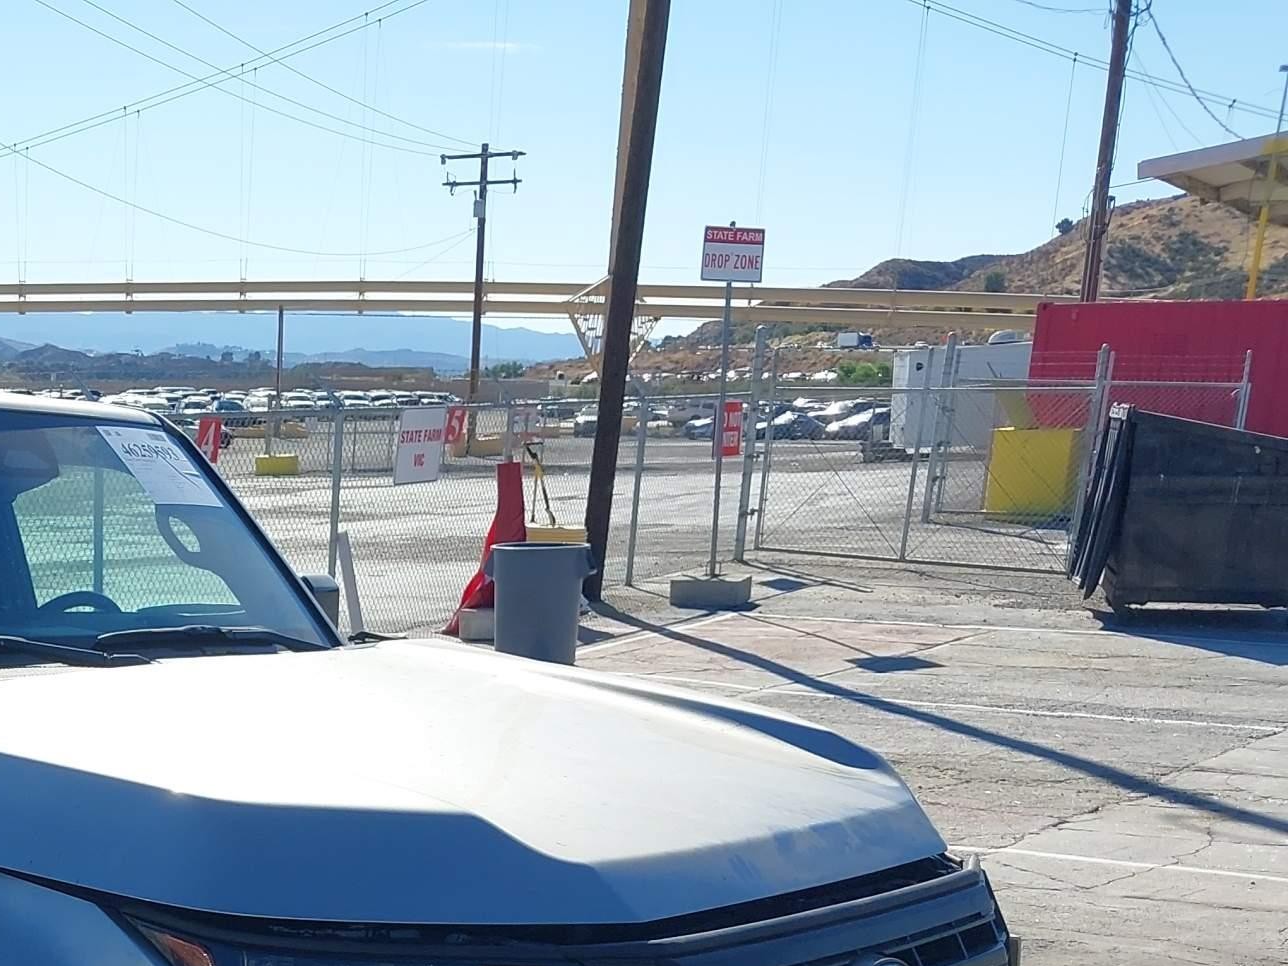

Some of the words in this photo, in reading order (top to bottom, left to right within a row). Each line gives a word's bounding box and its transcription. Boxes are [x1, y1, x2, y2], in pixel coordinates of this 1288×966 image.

[706, 230, 734, 241] STATE
[736, 231, 762, 242] FARM
[704, 253, 730, 269] DROP
[733, 254, 760, 270] ZONE
[447, 409, 463, 441] 5
[200, 420, 216, 462] 4
[400, 430, 423, 444] STATE
[423, 429, 443, 443] FARM
[120, 441, 180, 461] 46259593
